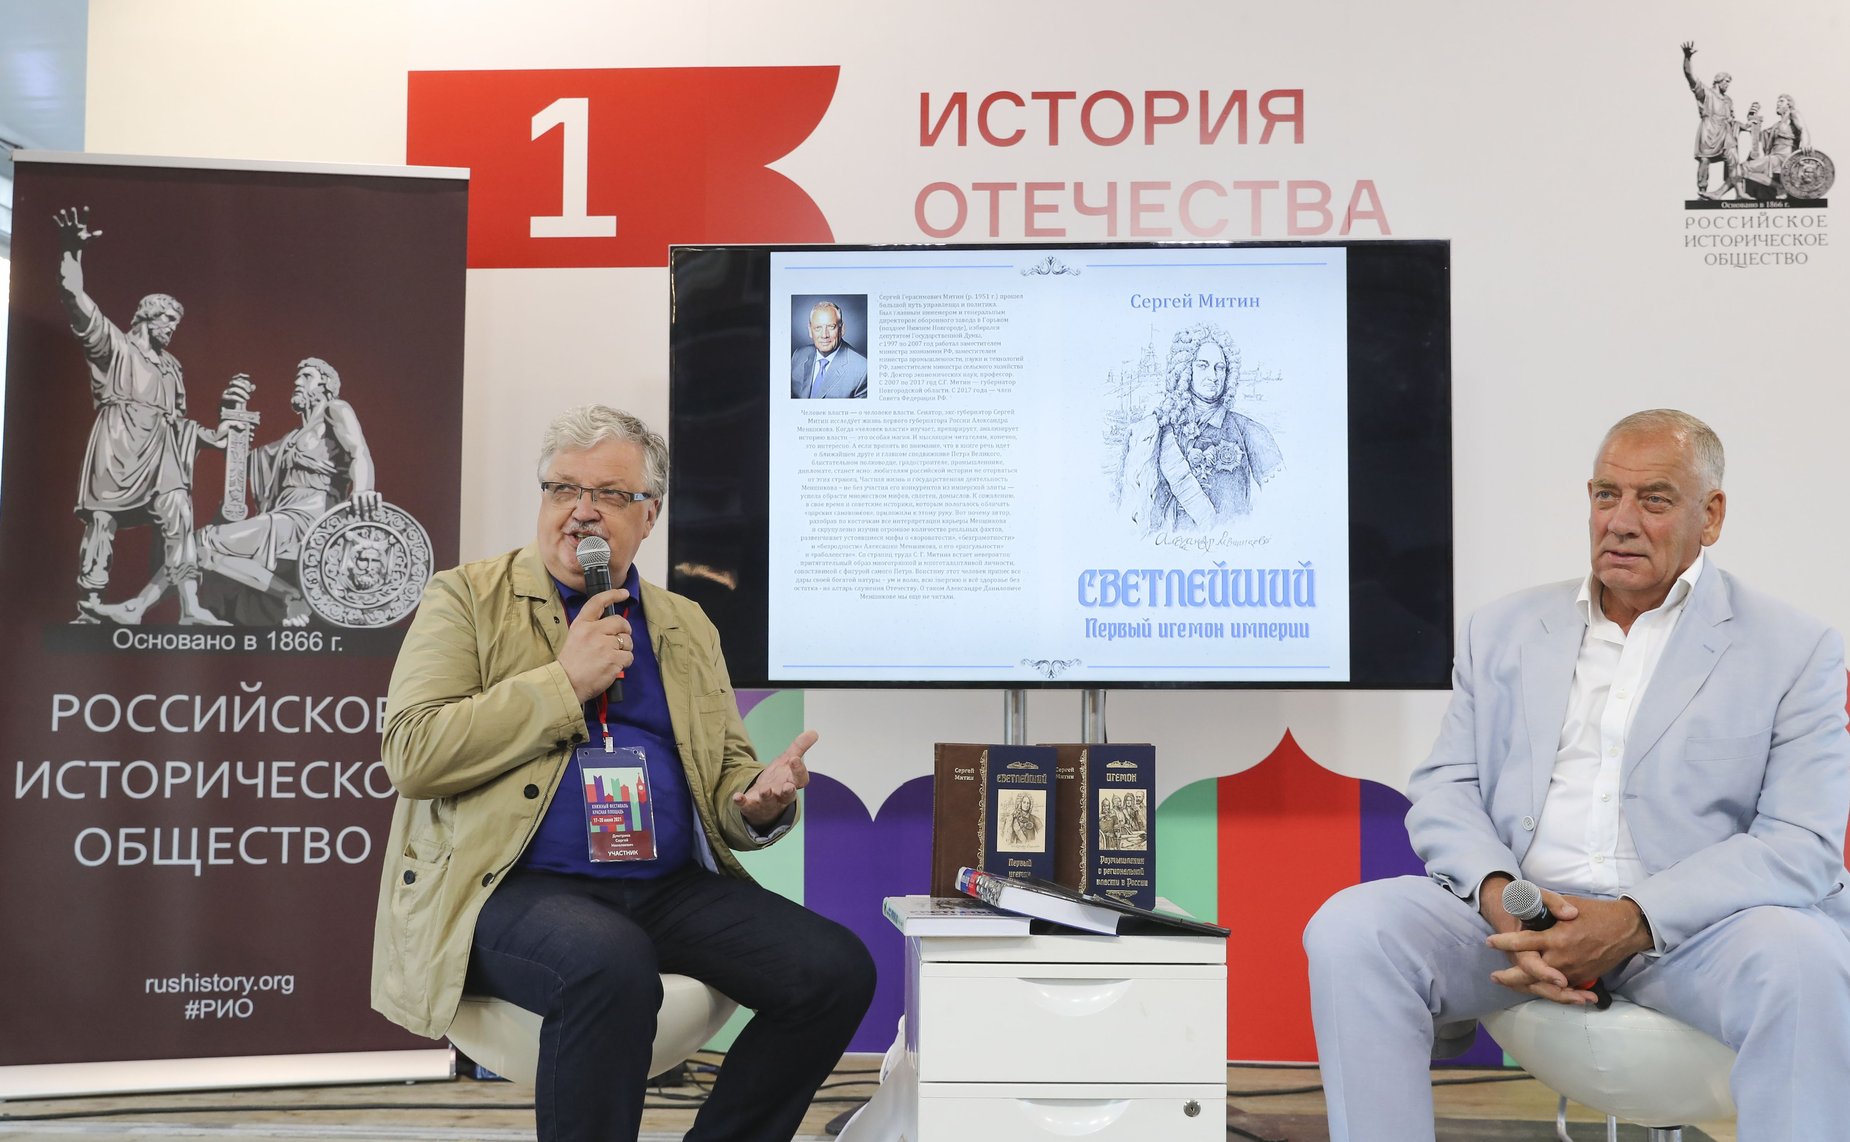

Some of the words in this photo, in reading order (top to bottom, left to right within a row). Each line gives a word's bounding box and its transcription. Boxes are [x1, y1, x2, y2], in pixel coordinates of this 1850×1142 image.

[920, 89, 1304, 147] ИСТОРИЯ
[531, 98, 617, 238] 1
[914, 179, 1392, 238] ОТЕЧЕСТВА
[1721, 201, 1758, 209] Основано
[1766, 200, 1784, 208] 1866
[1685, 211, 1828, 230] РОССИЙСКОЕ
[1684, 233, 1829, 248] ИСТОРИЧЕСКОЕ
[1704, 252, 1809, 268] ОБЩЕСТВО
[1130, 293, 1193, 311] Сергей
[1199, 293, 1261, 308] Митин
[1077, 561, 1317, 609] СВЕТЛЕЙШИЙ
[113, 628, 236, 651] Основано
[244, 636, 258, 650] в
[267, 628, 323, 651] 1866
[331, 635, 344, 651] г.
[1085, 618, 1152, 641] Первый
[1158, 622, 1224, 640] игемон
[1230, 622, 1310, 641] империи
[15, 760, 397, 800] ИСТОРИЧЕСКО
[954, 767, 975, 775] Сергей
[996, 773, 1048, 784] СВЕТЛЕЙШИЙ
[74, 826, 371, 877] ОБЩЕСТВО
[1126, 877, 1149, 888] России
[145, 972, 295, 996] rushistory.org
[184, 998, 254, 1020] #РИО
